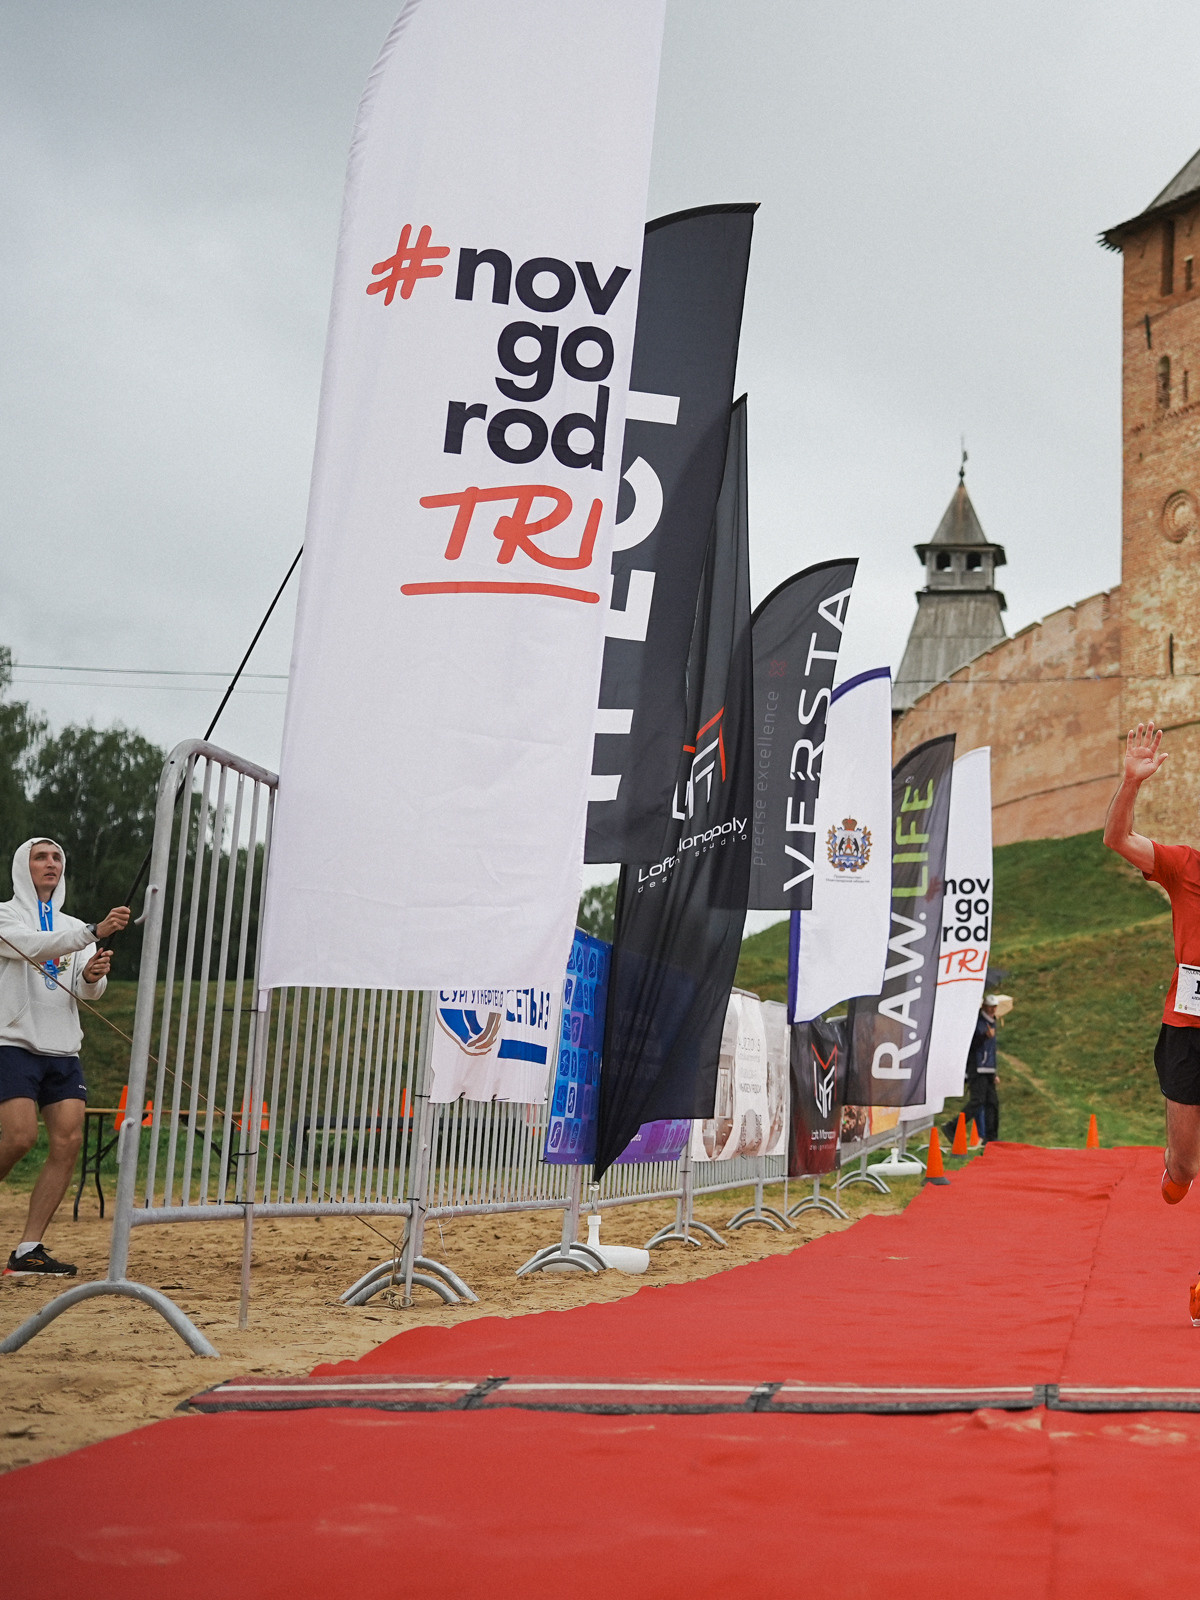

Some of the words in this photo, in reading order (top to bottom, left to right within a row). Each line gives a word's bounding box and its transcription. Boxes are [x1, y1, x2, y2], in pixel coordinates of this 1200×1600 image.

[366, 223, 632, 316] #nov
[495, 320, 614, 402] go
[443, 384, 610, 472] rod
[419, 484, 603, 570] TRI
[756, 690, 780, 792] excellence
[782, 587, 852, 892] VERSTA
[752, 799, 767, 867] precise
[891, 778, 935, 898] LIFE
[943, 916, 989, 942] rod
[955, 898, 990, 922] go
[940, 948, 988, 975] TRI
